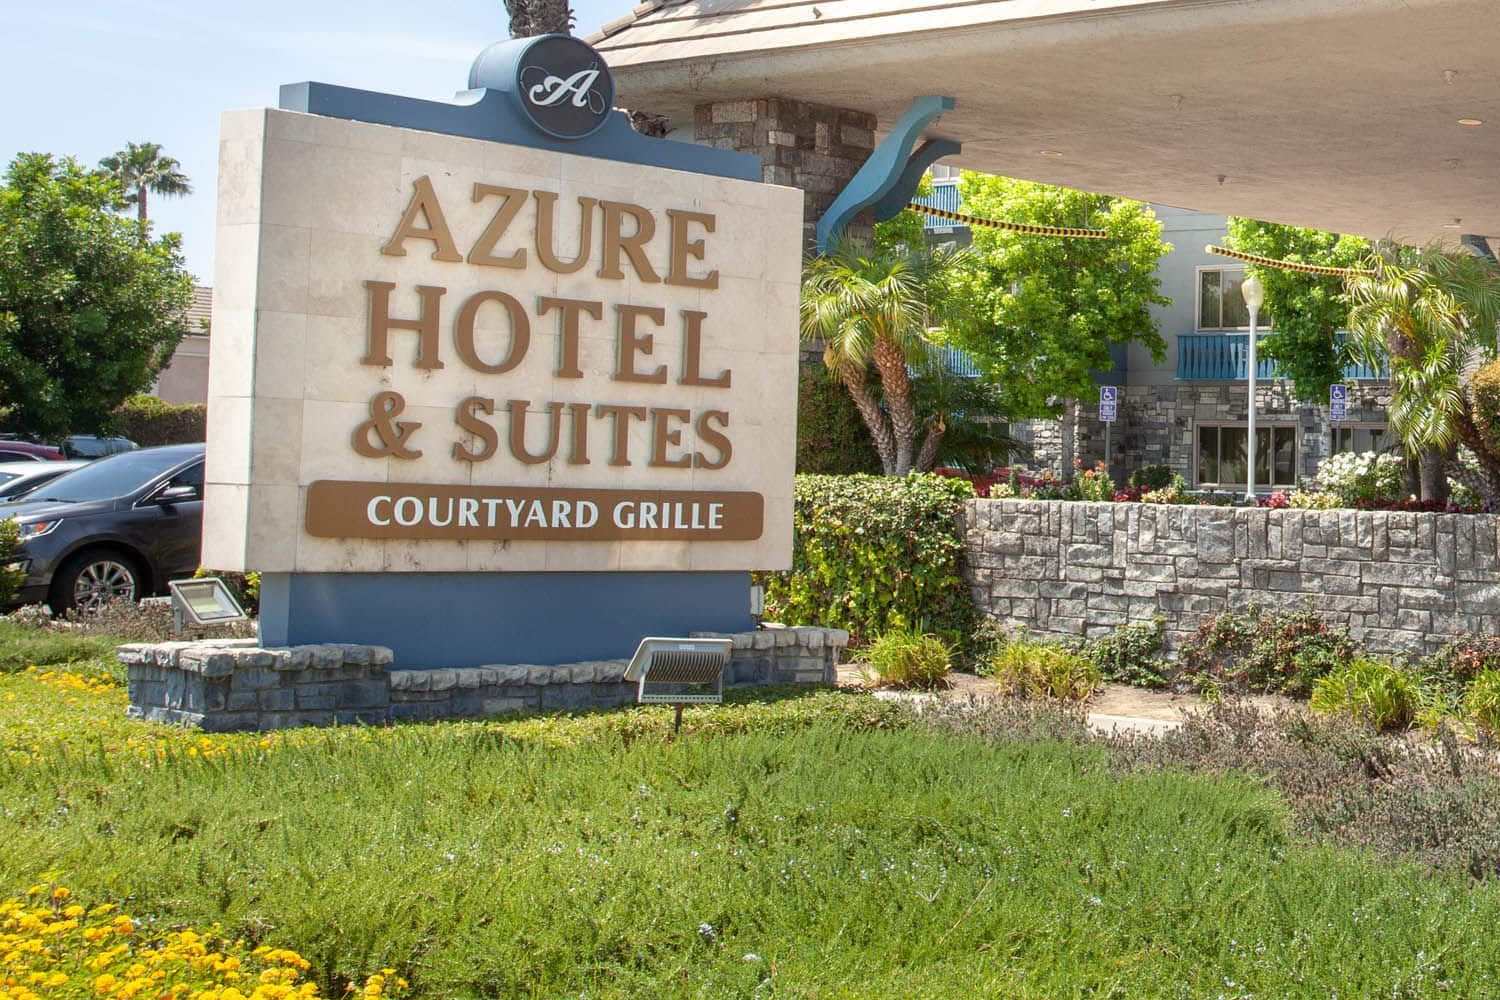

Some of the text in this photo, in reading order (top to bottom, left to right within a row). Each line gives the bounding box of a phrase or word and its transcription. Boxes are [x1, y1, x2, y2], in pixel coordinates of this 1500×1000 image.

[527, 66, 602, 109] A
[382, 175, 720, 290] AZURE
[361, 280, 732, 388] HOTEL
[351, 391, 734, 470] & SUITES
[366, 496, 725, 530] COURTYARD GRILLE
